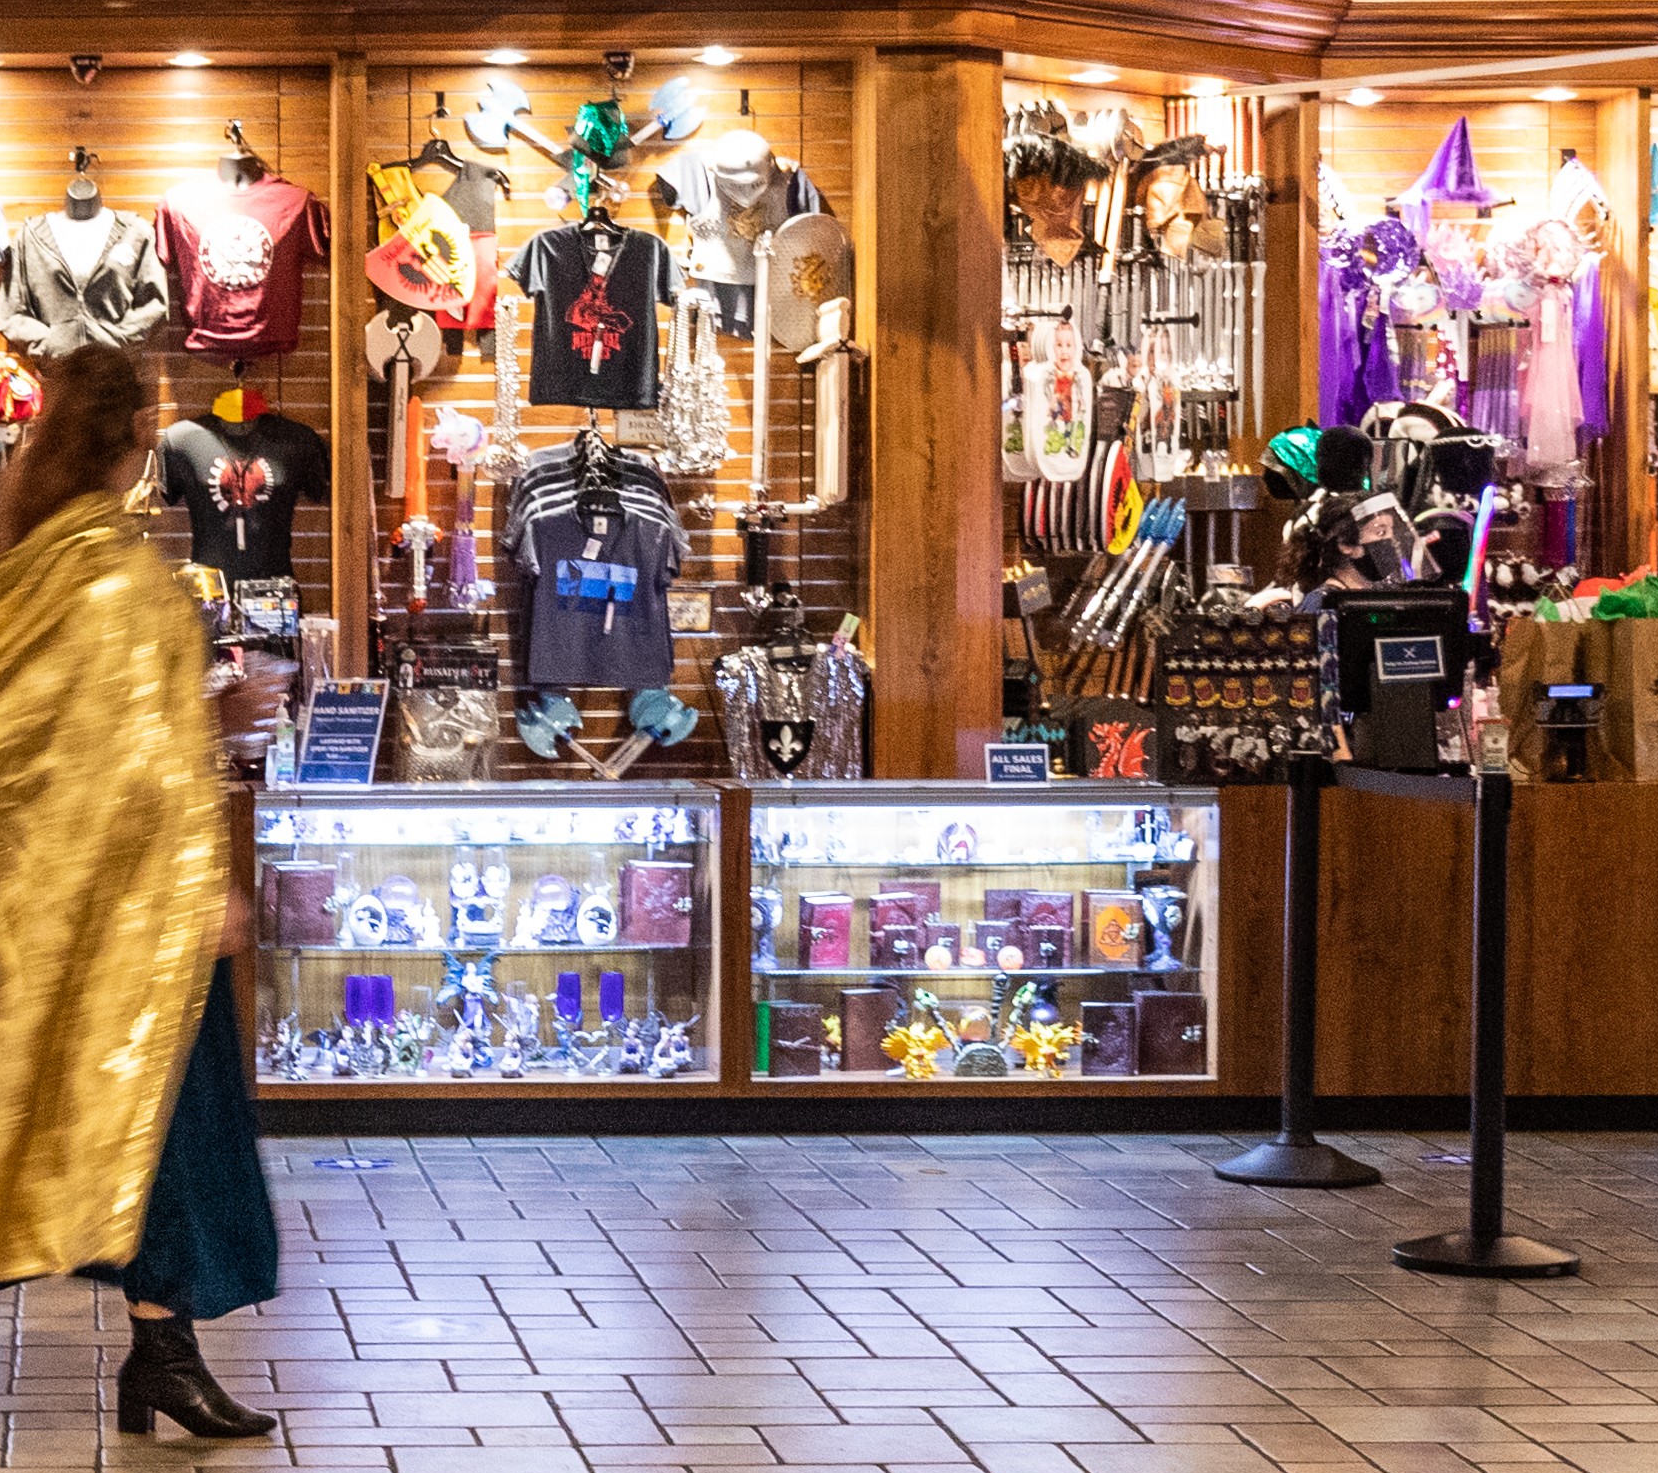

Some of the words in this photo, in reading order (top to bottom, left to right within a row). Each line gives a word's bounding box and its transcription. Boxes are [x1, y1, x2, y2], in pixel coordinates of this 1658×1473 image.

[313, 706, 336, 715] HAND
[338, 706, 380, 716] SANITIZER
[991, 754, 1011, 764] ALL
[1013, 754, 1043, 764] SALES
[1002, 764, 1033, 774] FINAL
